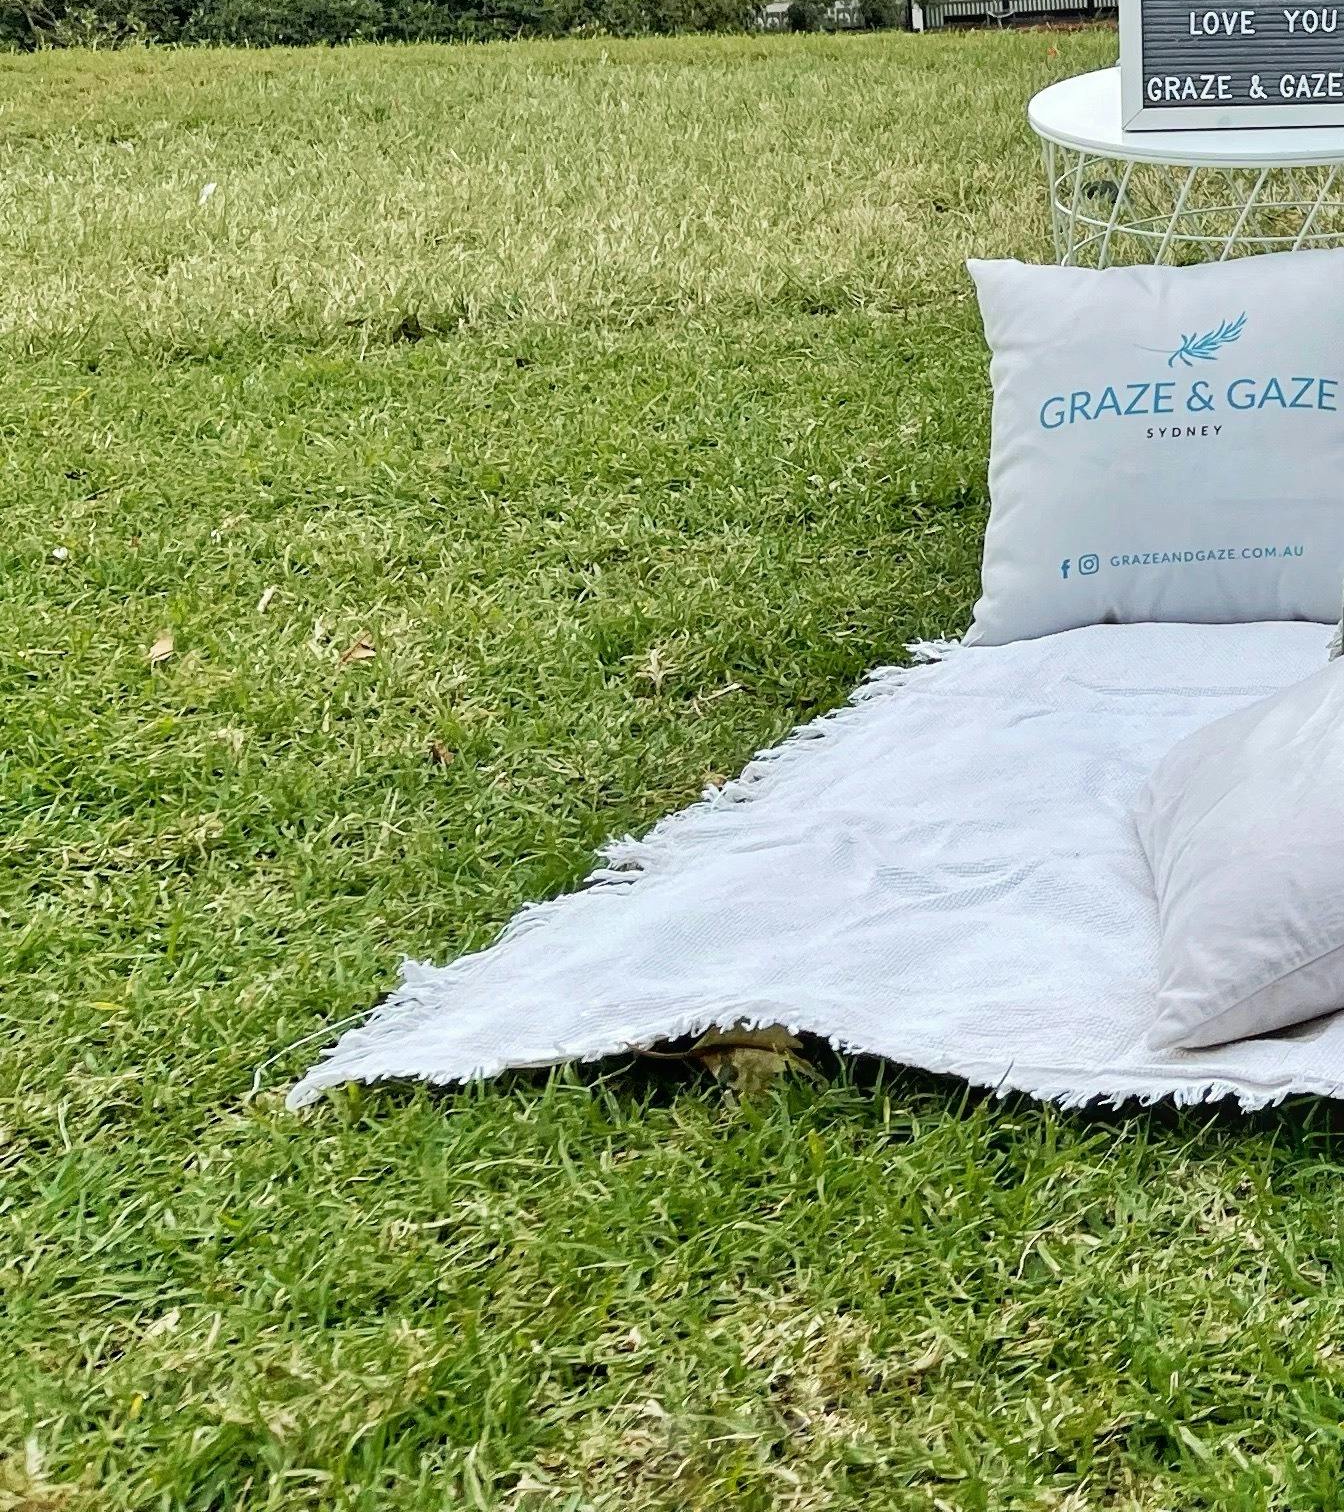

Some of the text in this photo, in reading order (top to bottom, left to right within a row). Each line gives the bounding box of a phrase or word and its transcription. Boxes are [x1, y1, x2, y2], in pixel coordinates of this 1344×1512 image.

[1189, 10, 1256, 36] LOVE
[1283, 8, 1337, 33] YOU
[1146, 72, 1344, 101] GRAZE & GAZE
[1039, 377, 1339, 429] GRAZE & GAZE
[1146, 425, 1224, 439] SYDNEY
[1110, 546, 1304, 567] GRAZEANDGAZE.COM.AU
